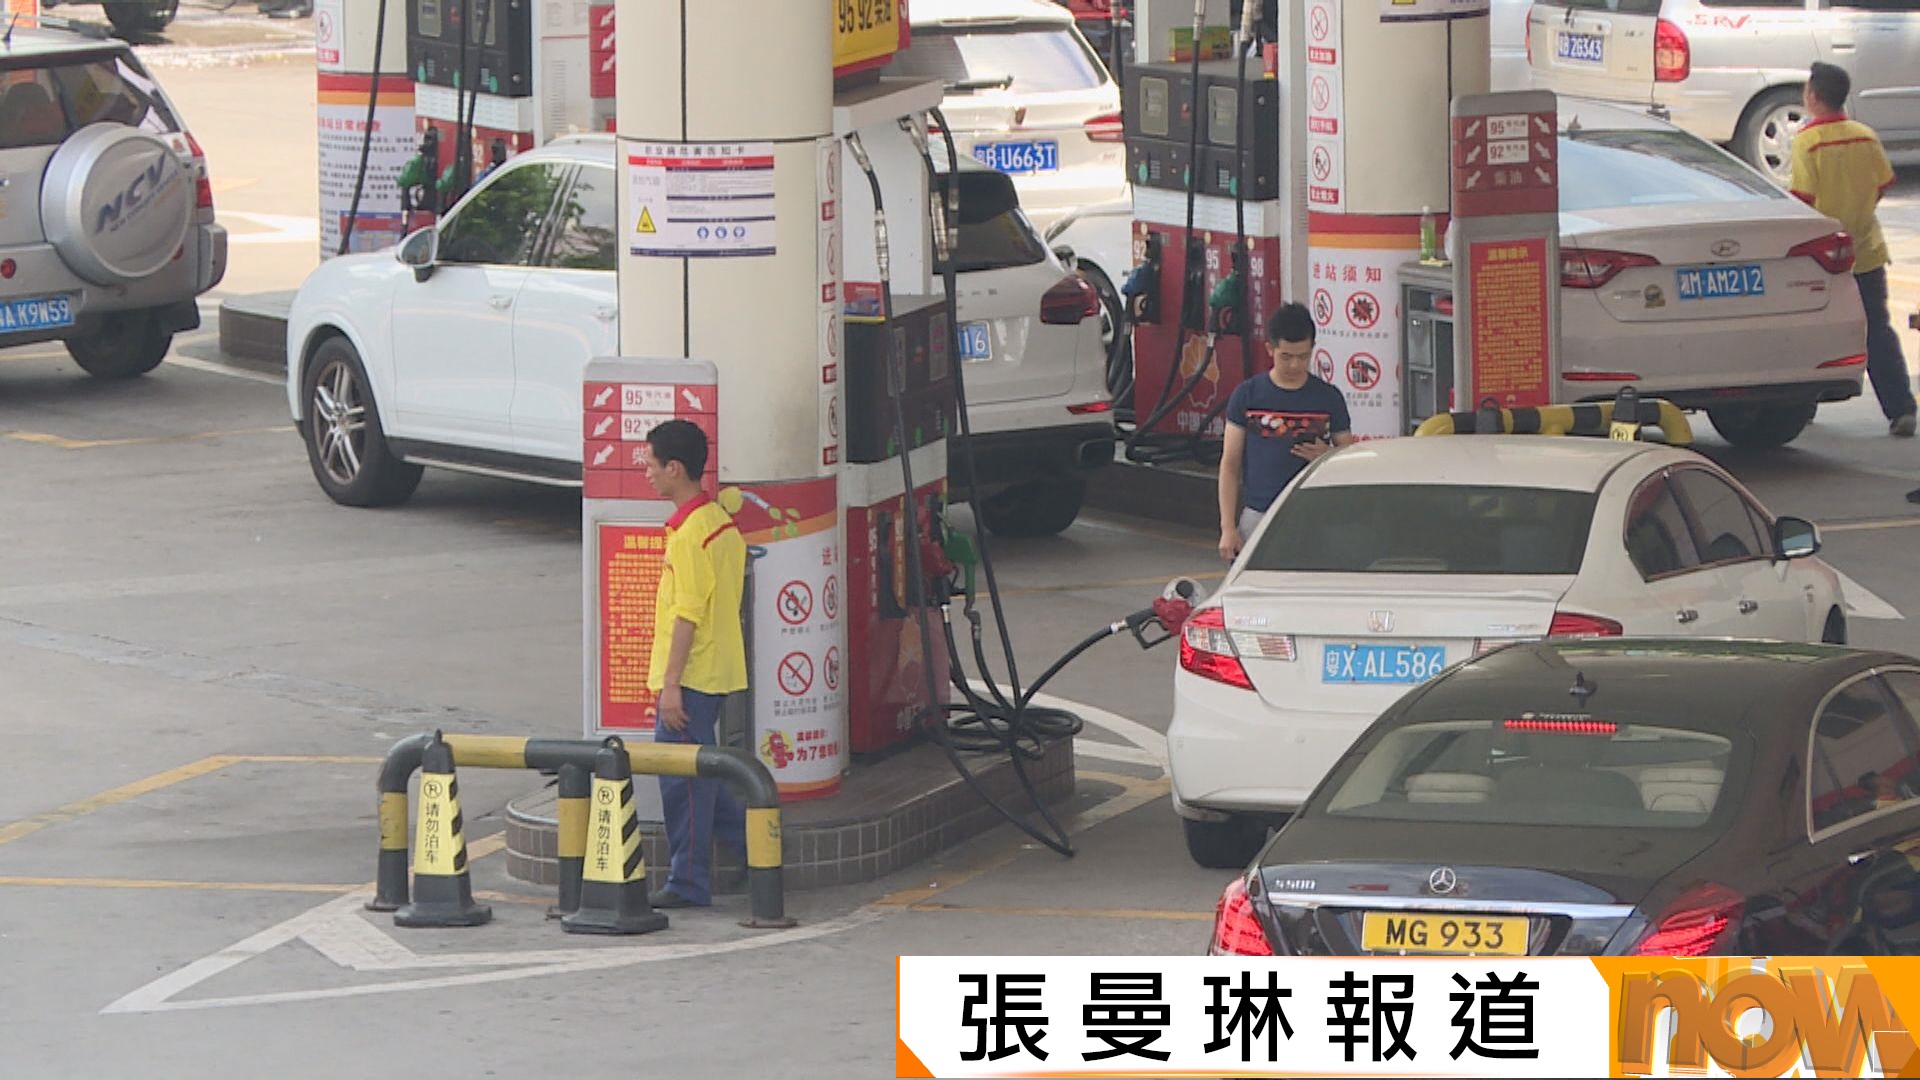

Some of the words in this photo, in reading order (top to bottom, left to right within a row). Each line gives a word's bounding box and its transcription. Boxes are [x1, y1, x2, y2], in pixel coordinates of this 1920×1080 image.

[1490, 120, 1505, 135] 95
[1490, 145, 1505, 160] 92
[1134, 239, 1148, 260] 92
[1206, 249, 1219, 270] 95
[1250, 256, 1264, 277] 98
[625, 390, 643, 406] 95
[624, 418, 641, 434] 92
[631, 445, 648, 466] 柴
[424, 802, 440, 865] 请勿泊车
[596, 808, 611, 872] 请勿泊车
[1386, 918, 1428, 946] MG
[1440, 920, 1504, 949] 933
